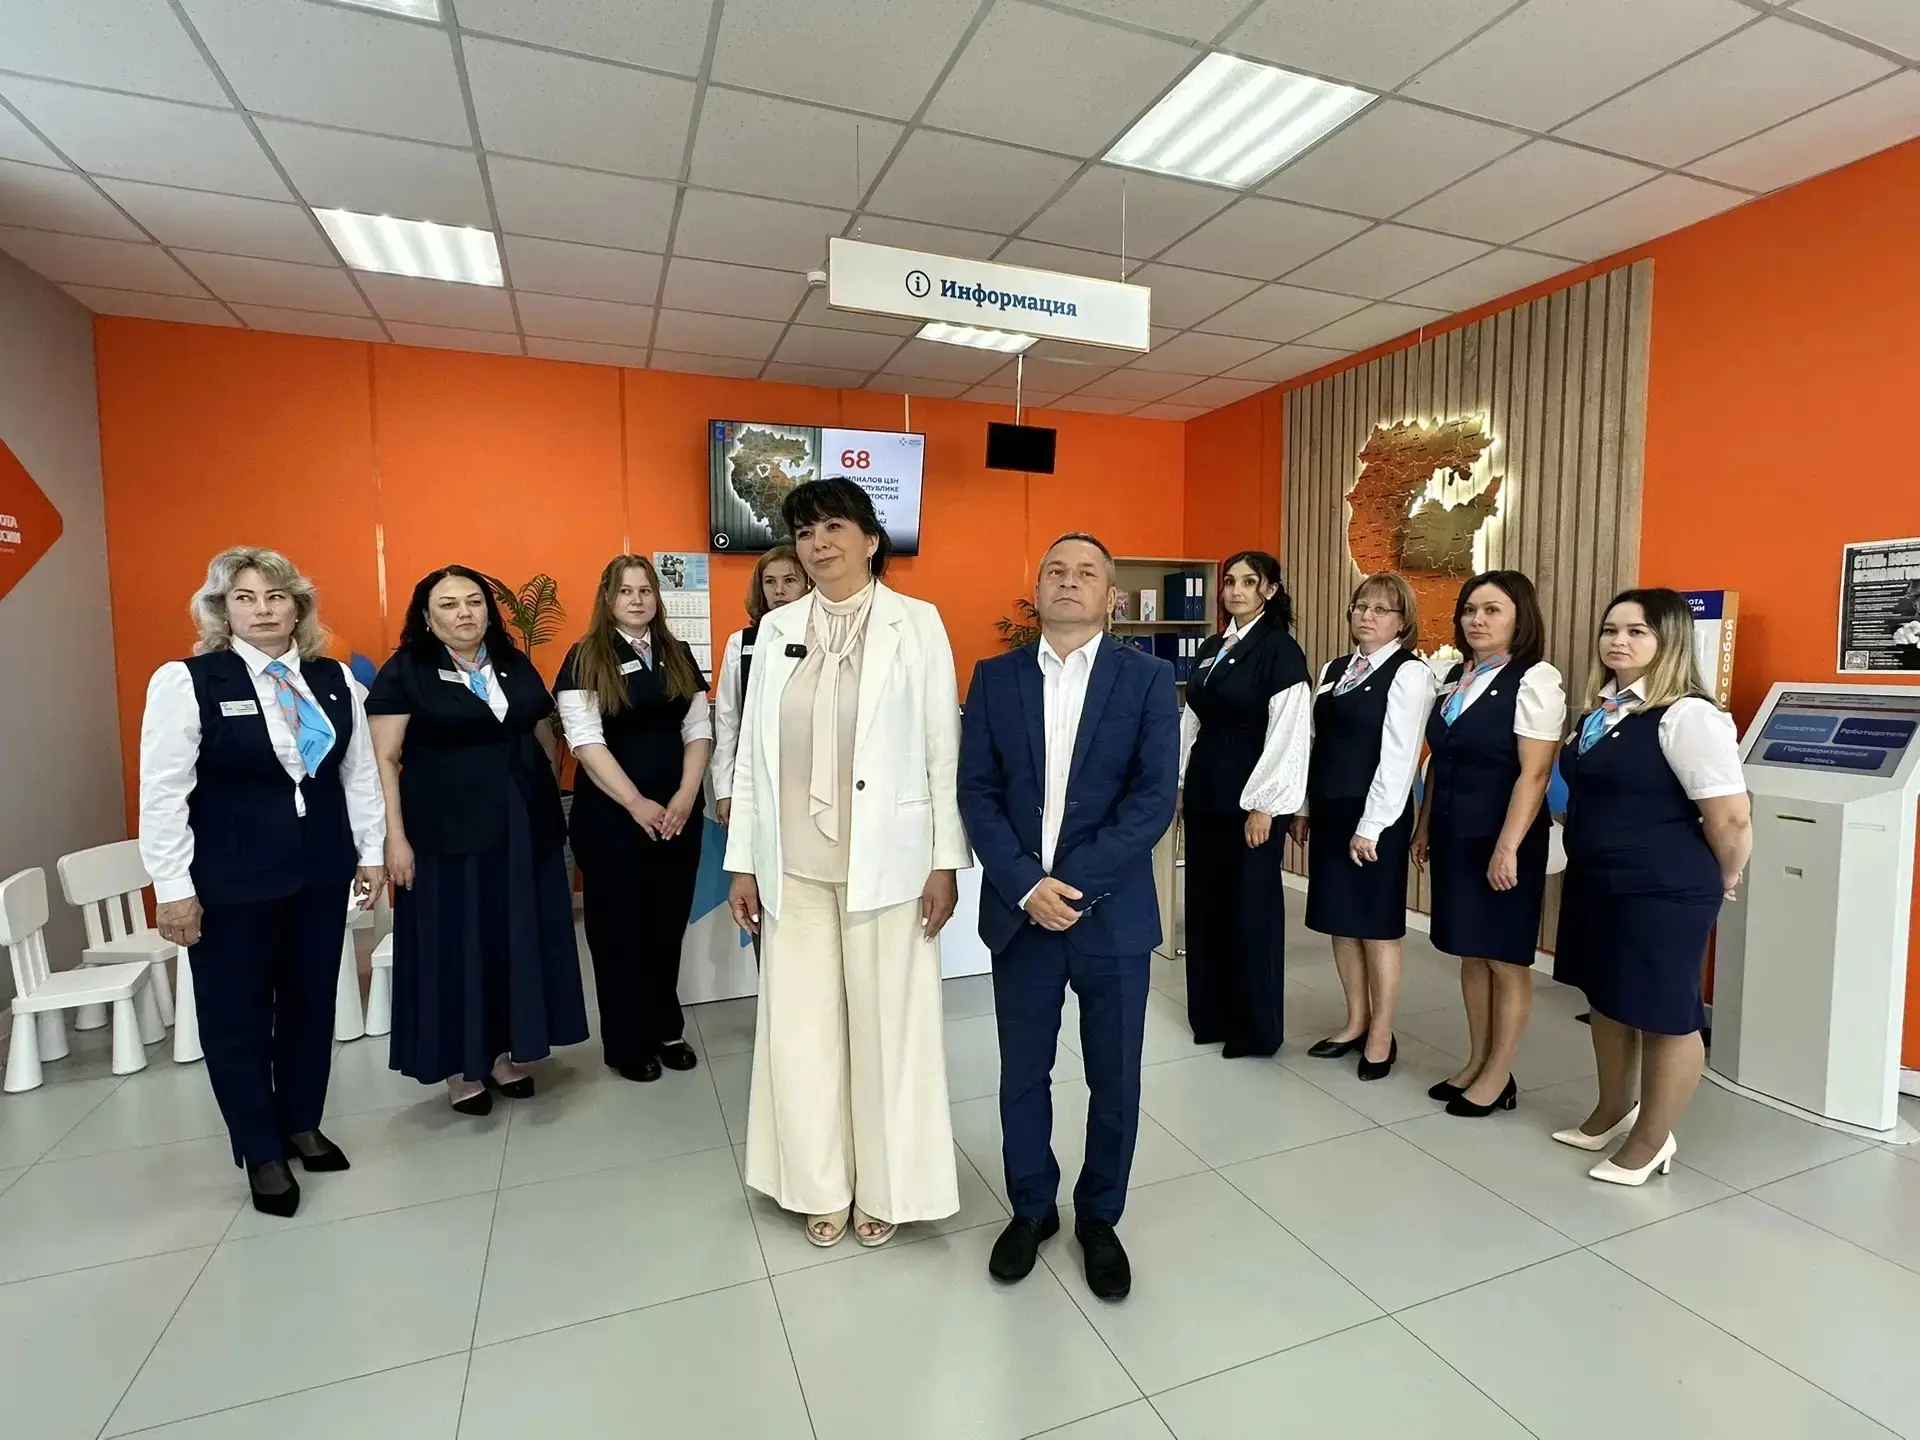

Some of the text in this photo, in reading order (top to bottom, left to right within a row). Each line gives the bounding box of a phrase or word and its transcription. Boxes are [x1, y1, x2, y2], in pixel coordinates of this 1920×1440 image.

[940, 279, 1078, 317] Информация
[840, 449, 871, 469] 68
[845, 475, 899, 485] ИЛИАЛОВ ЦЗН
[860, 484, 899, 492] СПУБЛИКЕ
[0, 514, 18, 528] ОТА
[1723, 620, 1734, 672] собой
[1839, 727, 1909, 738] Работодатели
[1783, 745, 1869, 758] Предварительная
